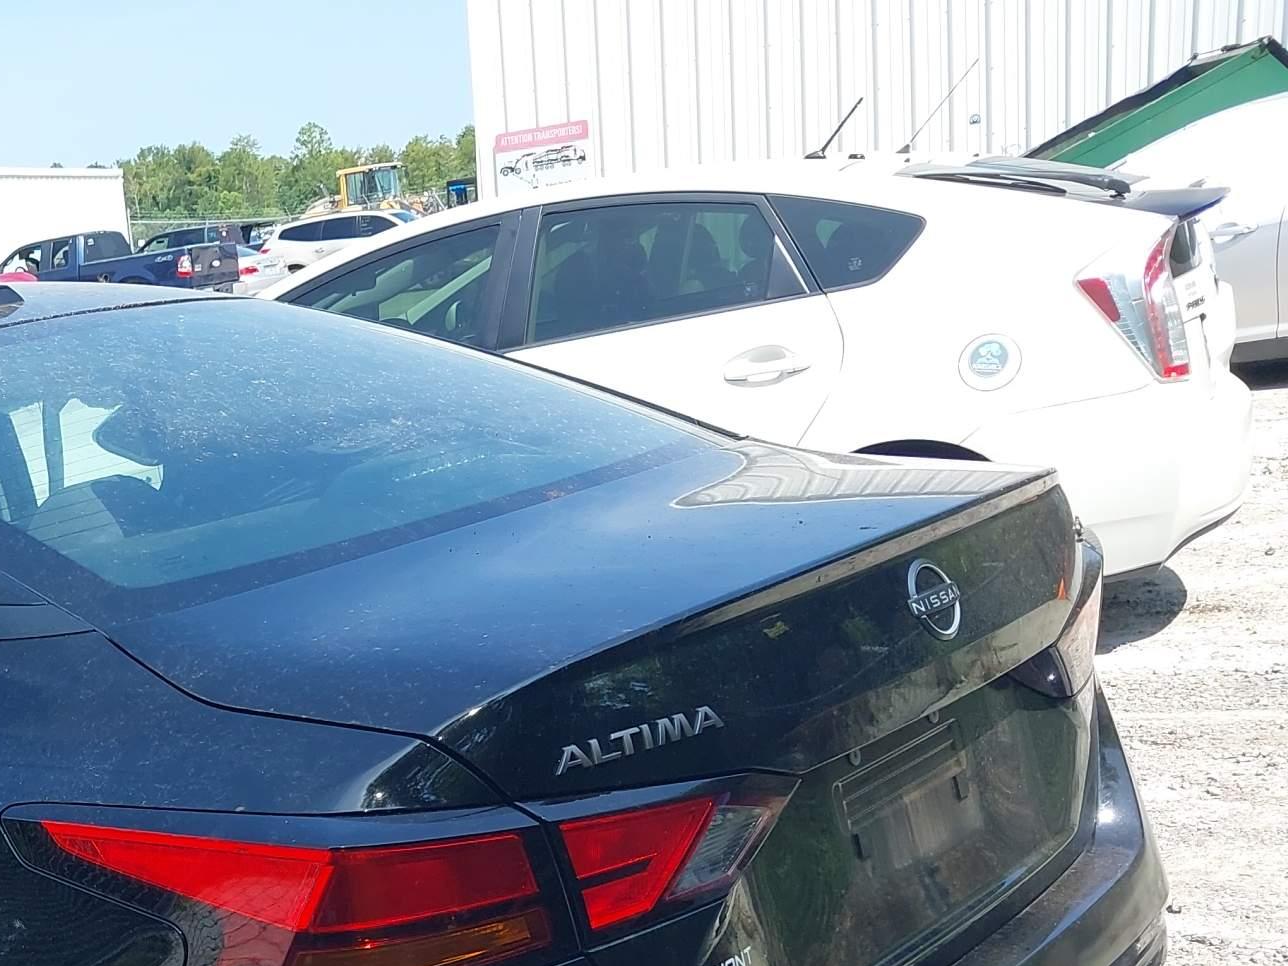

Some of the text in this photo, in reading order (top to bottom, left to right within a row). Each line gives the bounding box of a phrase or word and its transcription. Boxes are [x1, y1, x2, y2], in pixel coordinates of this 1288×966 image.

[500, 134, 533, 146] ATTENTION
[911, 585, 960, 615] NISSAN
[555, 705, 725, 776] ALTIMA
